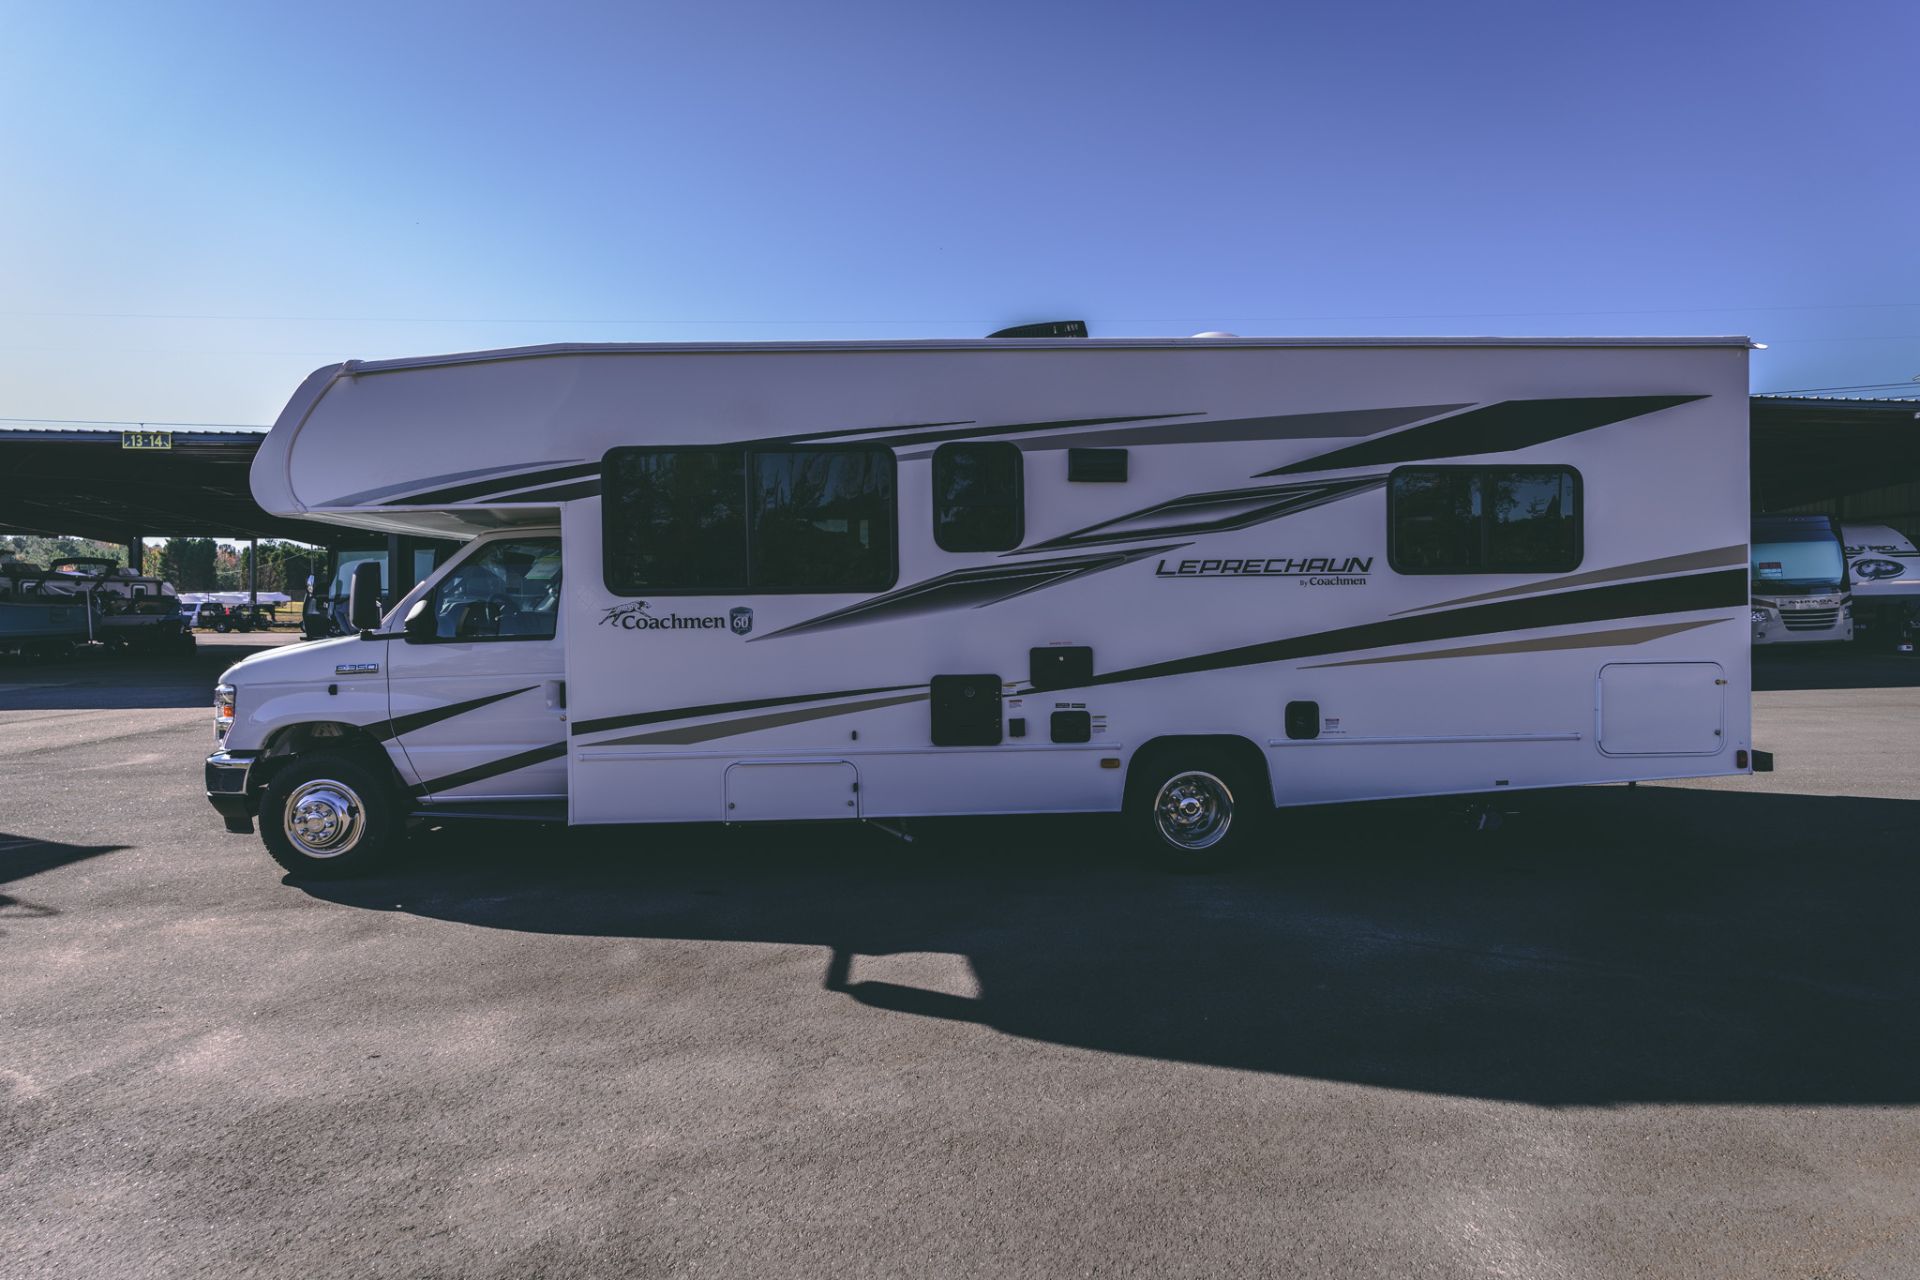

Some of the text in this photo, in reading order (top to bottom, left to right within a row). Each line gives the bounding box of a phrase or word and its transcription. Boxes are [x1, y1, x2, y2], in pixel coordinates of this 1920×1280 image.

[130, 434, 163, 447] 13-14
[1155, 557, 1373, 575] LEPRECHAUN
[1309, 576, 1366, 586] Coachmen
[622, 613, 725, 630] Coachmen
[733, 616, 749, 628] 60
